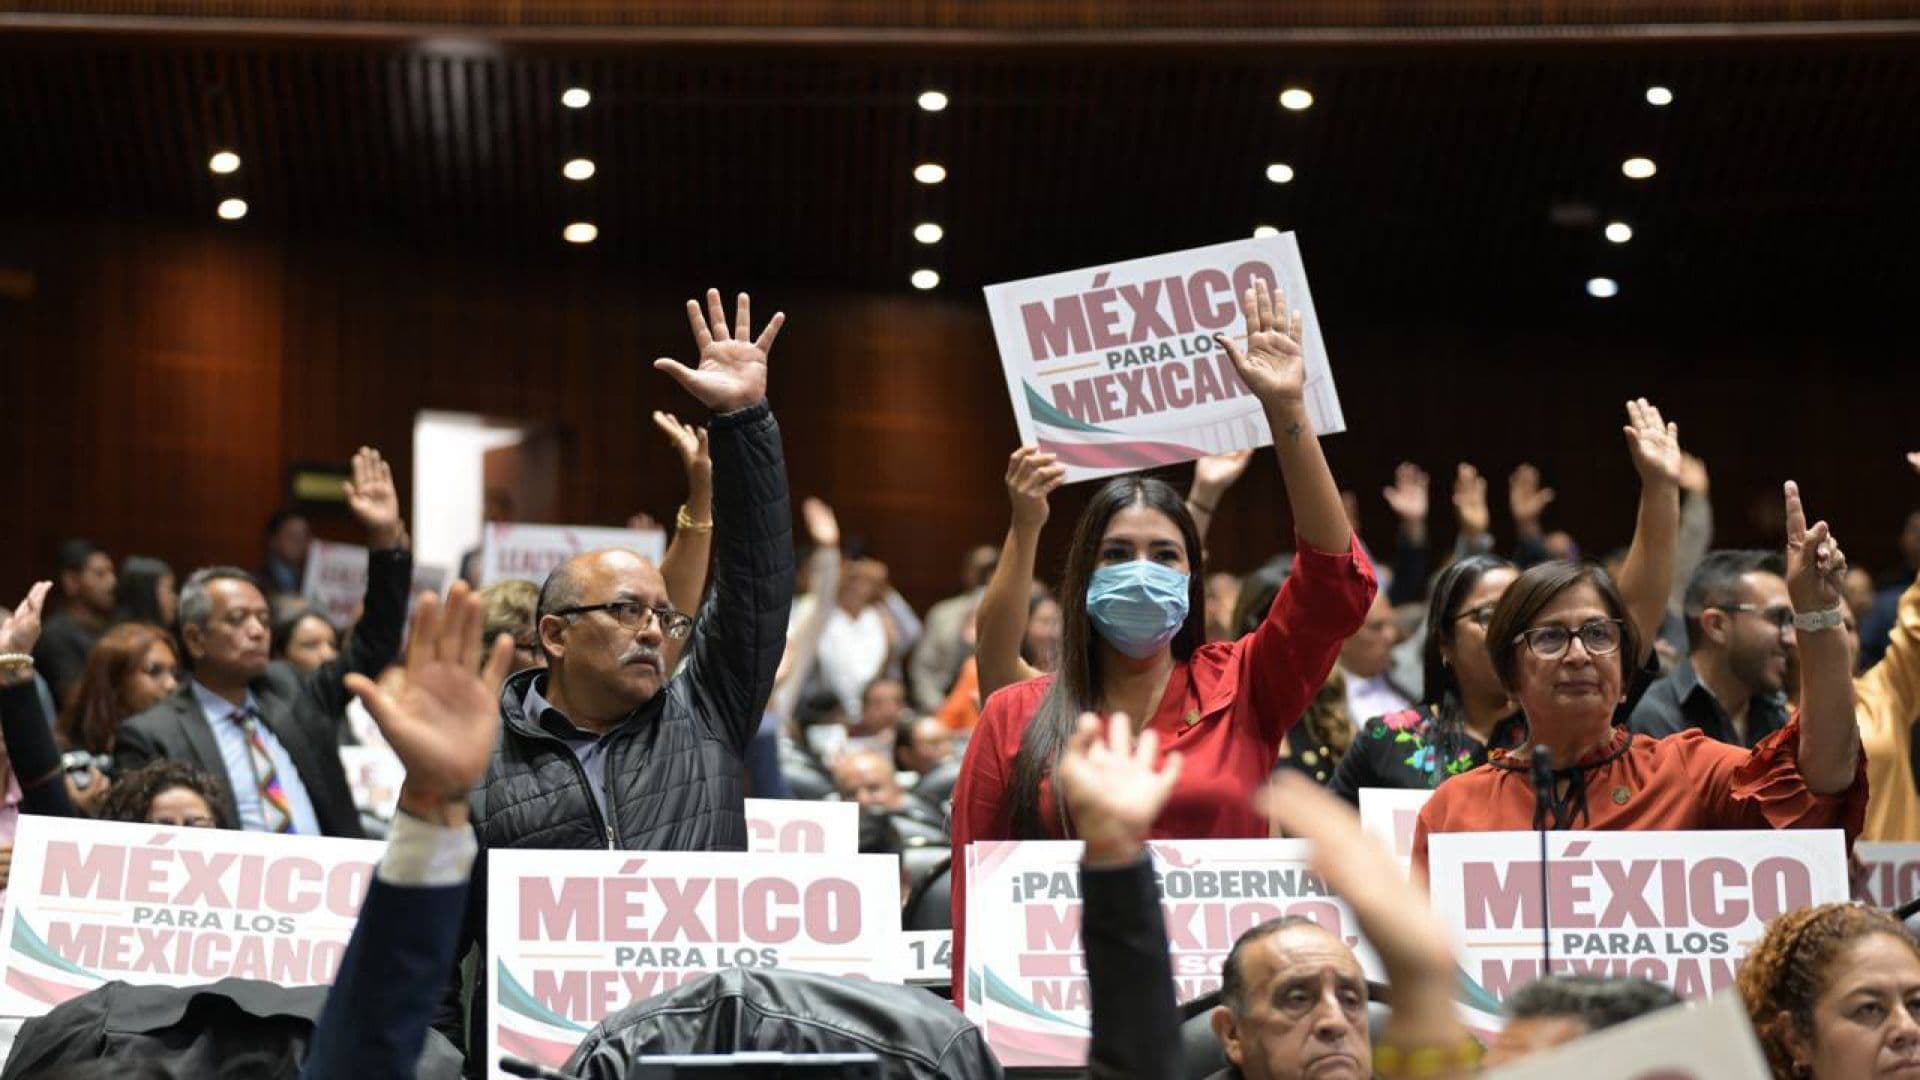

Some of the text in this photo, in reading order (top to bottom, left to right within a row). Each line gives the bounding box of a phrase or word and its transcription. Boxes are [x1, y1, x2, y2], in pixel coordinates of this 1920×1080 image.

[1051, 353, 1254, 425] MEXICAN
[1106, 342, 1175, 371] PARA
[40, 833, 375, 918] MÉXICO
[518, 859, 862, 944] MÉXICO
[1462, 841, 1812, 929] MÉXICO
[133, 906, 296, 934] PARA LOS
[1563, 932, 1729, 954] PARA LOS
[47, 921, 348, 986] MEXICANO
[614, 946, 779, 968] PARA LOS
